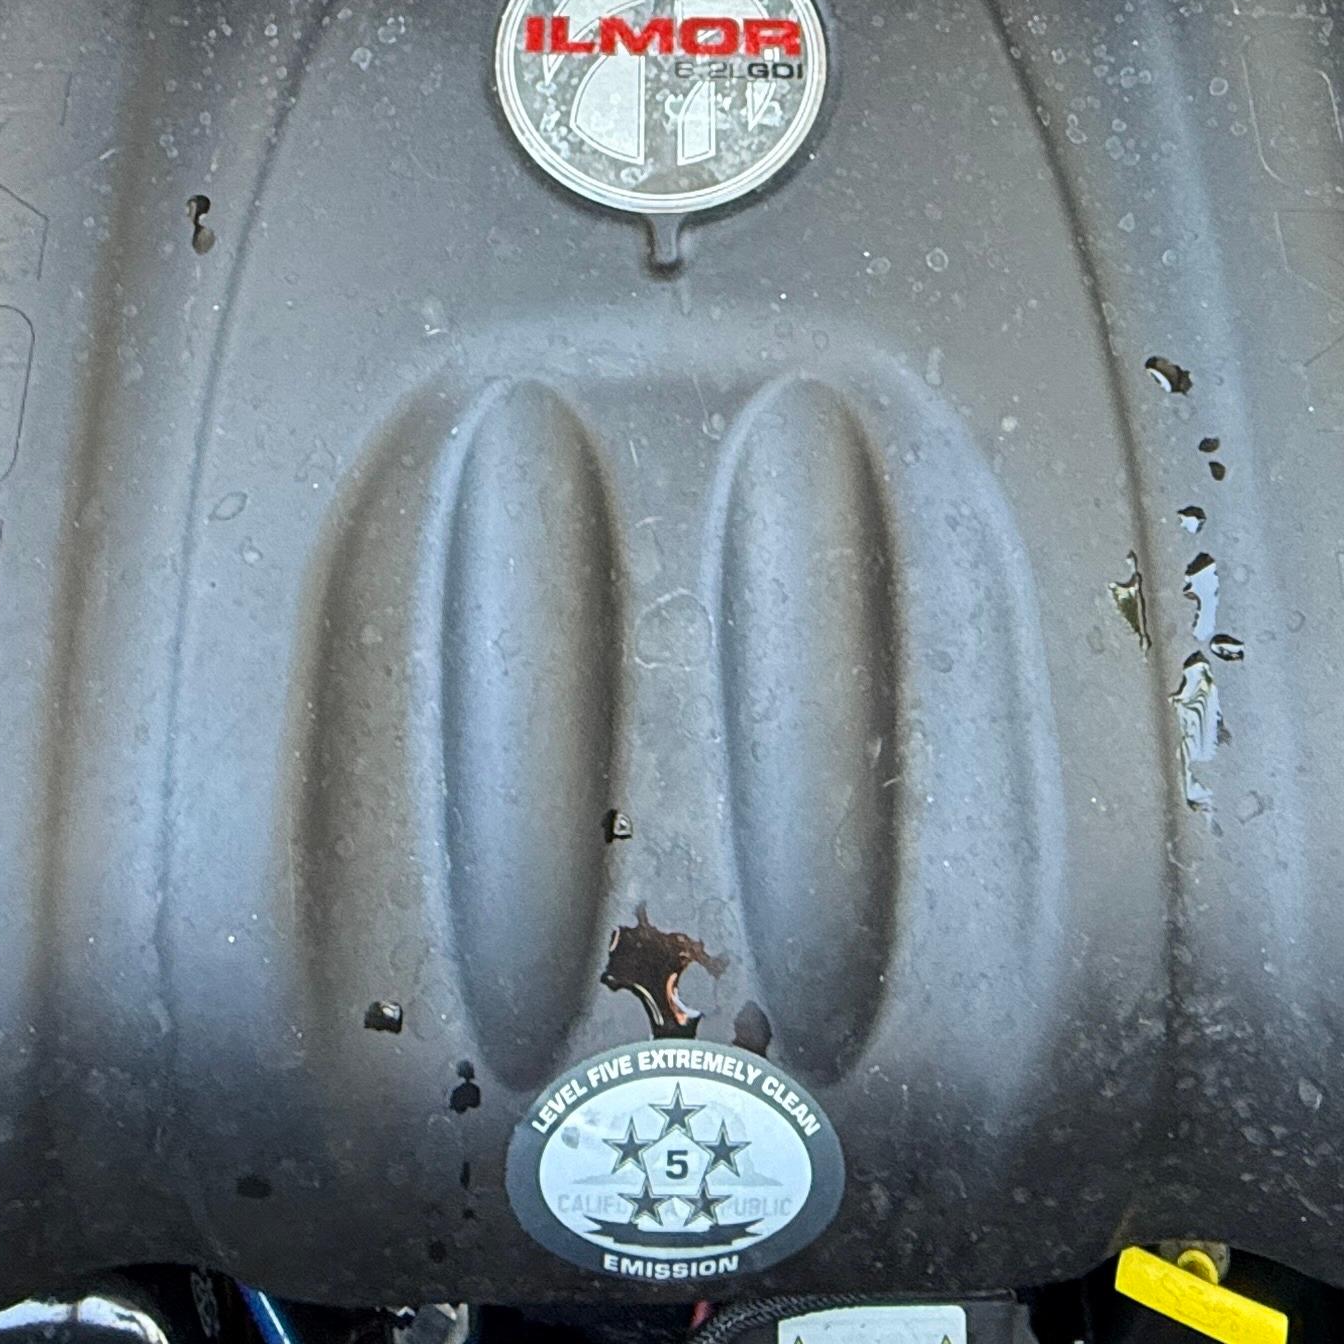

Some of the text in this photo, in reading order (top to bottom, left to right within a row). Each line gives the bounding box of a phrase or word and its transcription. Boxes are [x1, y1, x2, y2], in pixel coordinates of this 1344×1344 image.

[524, 16, 802, 57] ILMOR
[531, 1049, 821, 1137] LEVEL FIVE EXTREMELY CLEAN
[665, 1150, 689, 1180] 5
[603, 1254, 739, 1280] EMISSION
